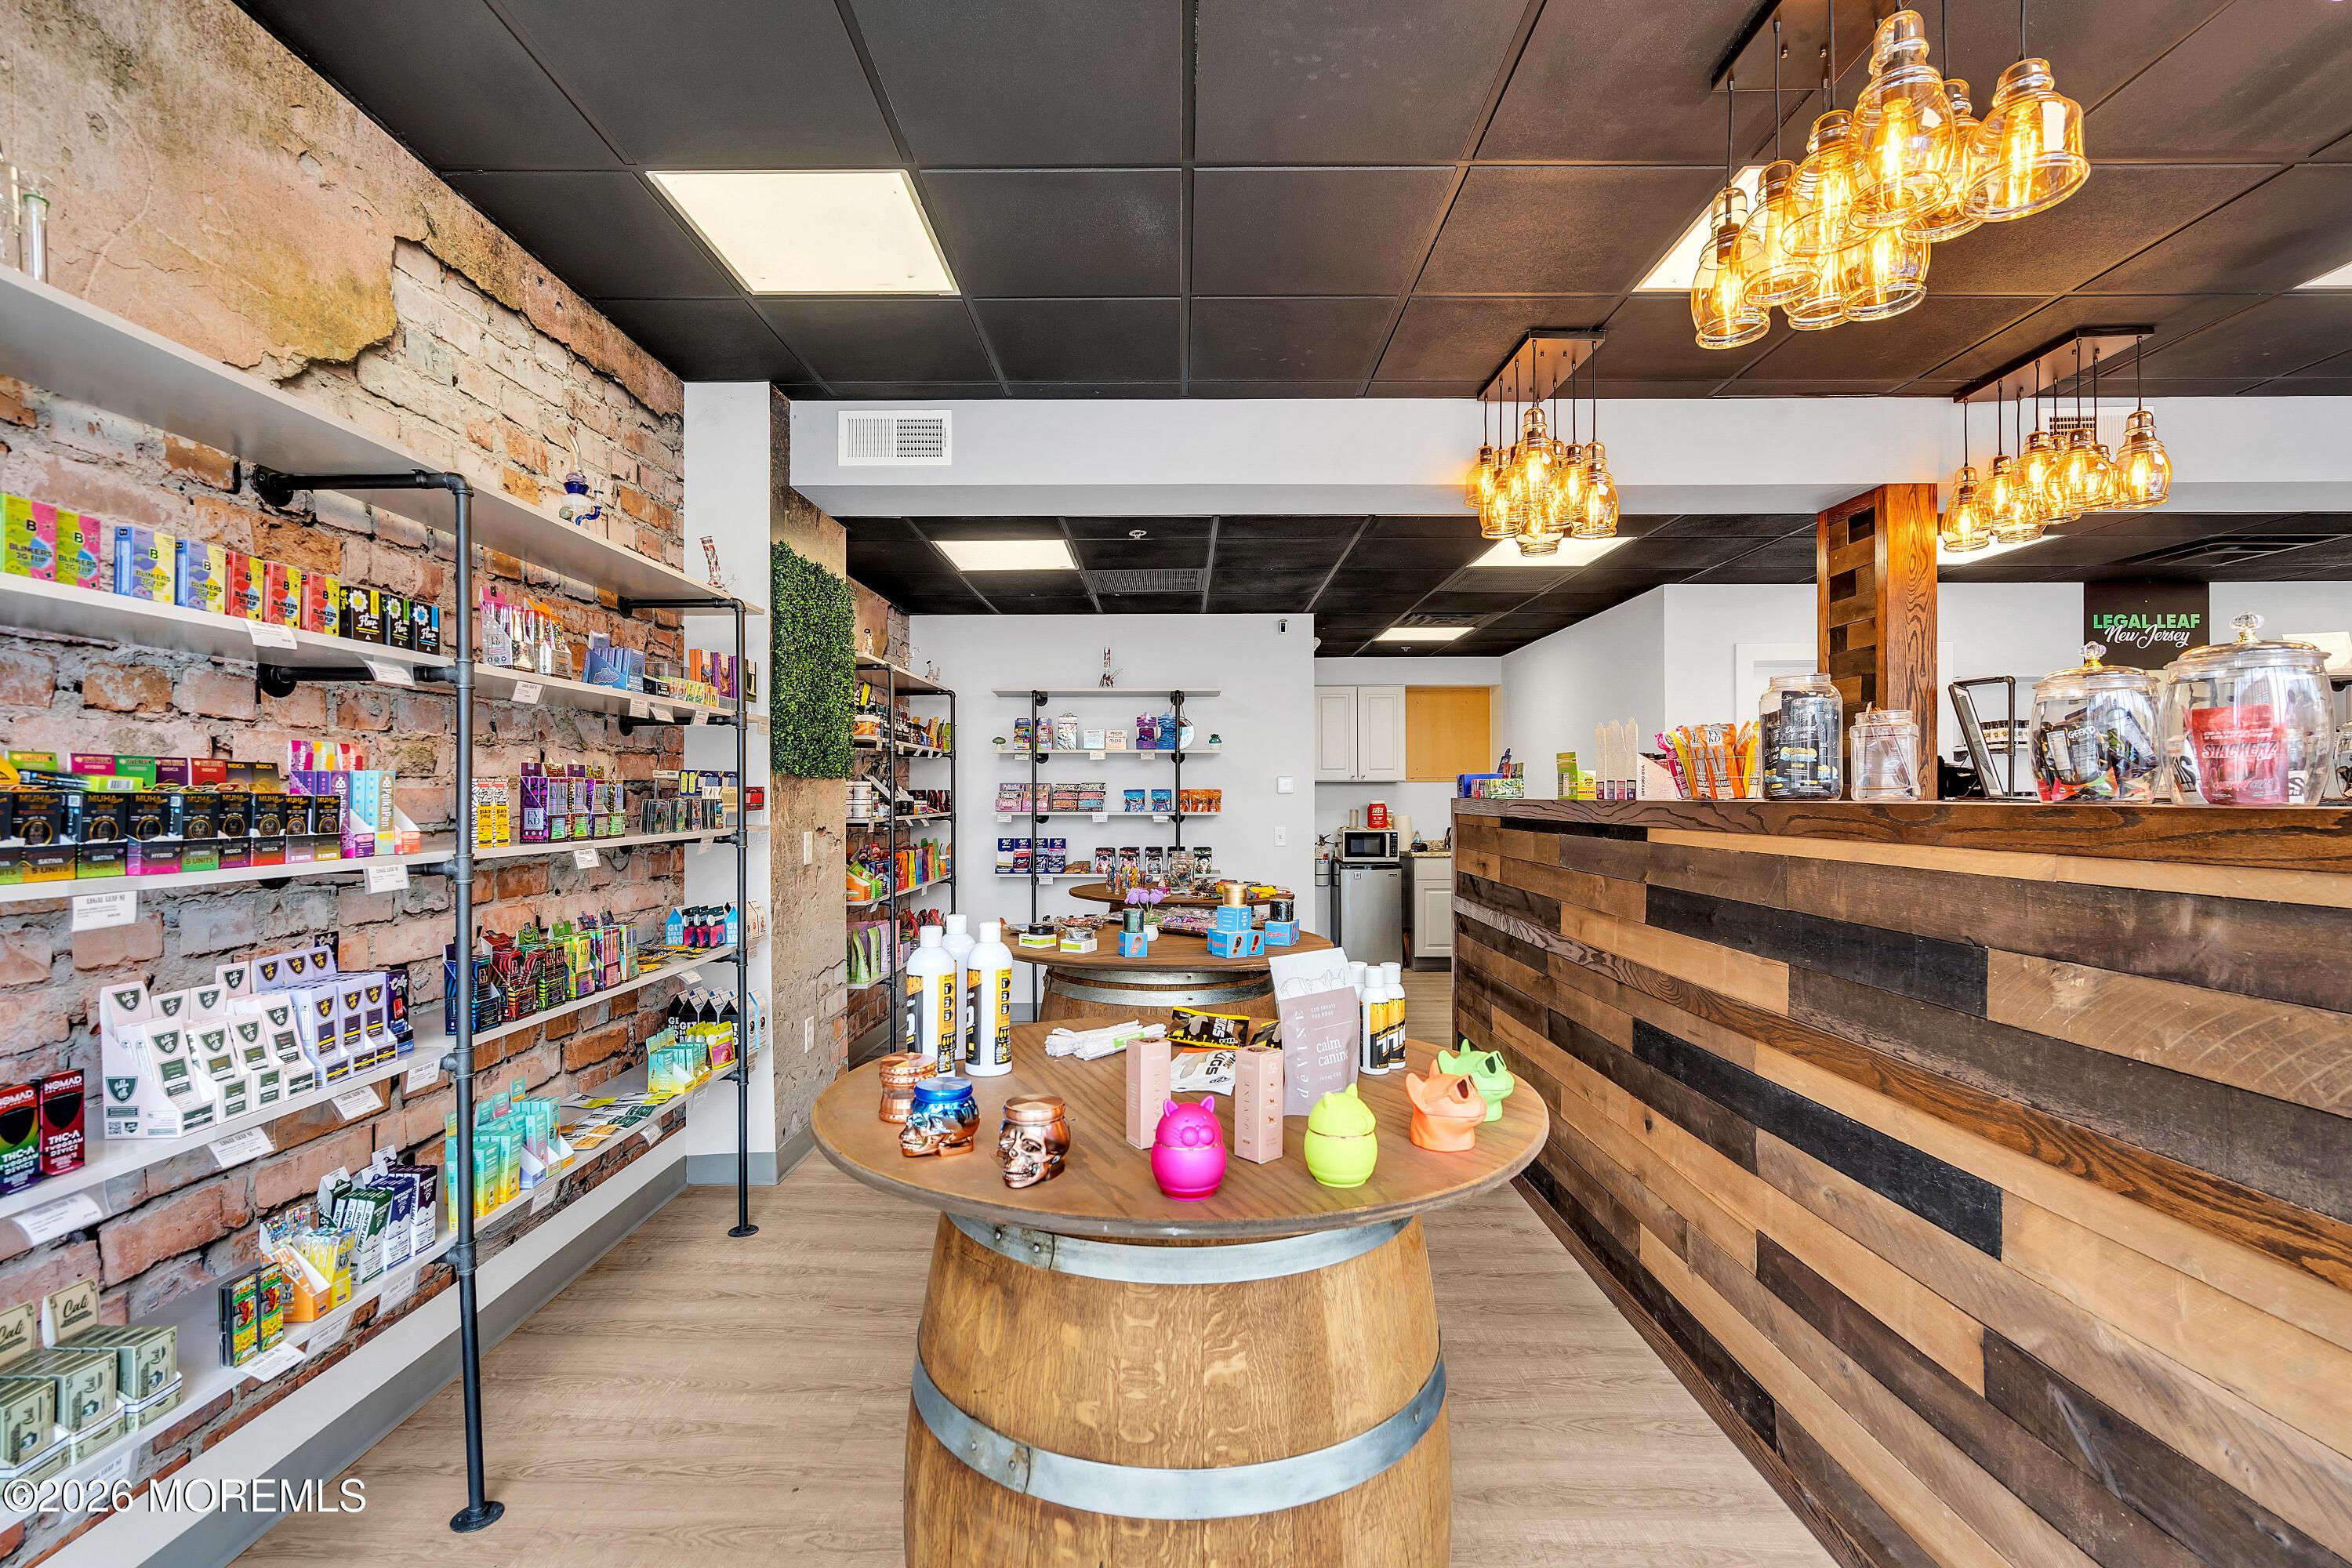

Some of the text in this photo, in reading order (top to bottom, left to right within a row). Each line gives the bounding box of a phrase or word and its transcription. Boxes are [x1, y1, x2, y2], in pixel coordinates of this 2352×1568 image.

[27, 519, 37, 532] B
[74, 532, 84, 543] B
[9, 543, 53, 557] BLINKERS
[150, 548, 158, 559] B
[58, 554, 97, 569] BLINKERS
[204, 561, 212, 571] B
[136, 570, 171, 583] BLINKERS
[245, 572, 252, 581] B
[191, 580, 223, 593] BLINKERS
[283, 581, 290, 590] B
[234, 590, 260, 602] BLINKERS
[323, 590, 329, 600] B
[273, 600, 298, 611] BLINKERS
[313, 608, 337, 619] BLINKERS
[2093, 613, 2201, 629] LEGAL LEAF
[2104, 623, 2191, 649] New Jersey
[41, 866, 70, 874] UNITS
[1316, 1036, 1342, 1054] calm
[45, 1076, 83, 1092] NOMAD
[50, 1144, 78, 1157] DEVICE
[5, 1160, 34, 1176] DEVICE
